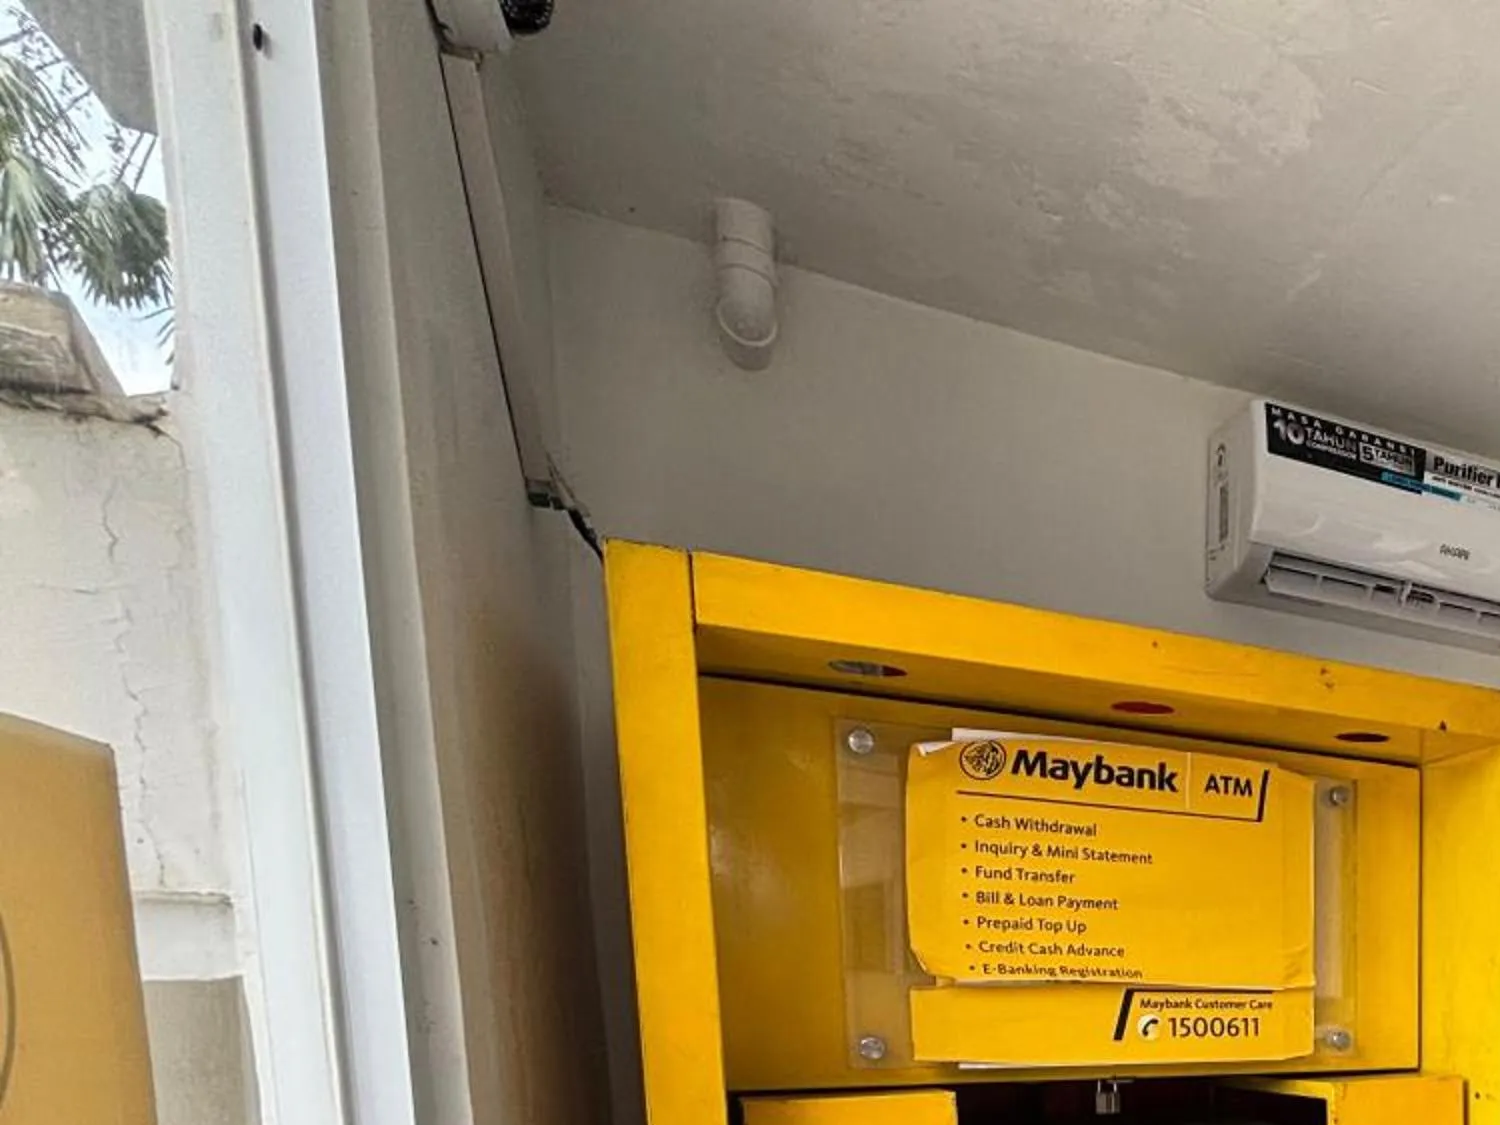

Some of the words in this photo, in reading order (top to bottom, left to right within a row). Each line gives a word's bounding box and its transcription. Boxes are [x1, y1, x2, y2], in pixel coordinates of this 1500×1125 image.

[1271, 406, 1323, 429] MASA
[1273, 418, 1306, 445] 10
[1306, 427, 1357, 451] TAHUN
[1362, 443, 1376, 462] 5
[1433, 455, 1494, 487] Purifier
[1010, 749, 1179, 792] Maybank
[1204, 773, 1253, 798] ATM
[974, 814, 1011, 830] Cash
[1014, 817, 1097, 837] Withdrawal
[974, 839, 1029, 859] Inquiry
[1031, 843, 1042, 857] &
[1046, 845, 1079, 860] Mini
[1082, 848, 1153, 866] Statement
[975, 865, 1013, 881] Fund
[1016, 867, 1076, 884] Transfer
[975, 890, 999, 904] Bill
[1003, 892, 1015, 905] &
[1019, 892, 1051, 907] Loan
[1057, 895, 1119, 912] Payment
[976, 915, 1033, 933] Prepaid
[1037, 917, 1063, 934] Top
[1066, 920, 1087, 935] Up
[978, 940, 1024, 955] Credit
[1028, 943, 1063, 956] Cash
[1066, 944, 1125, 958] Advance
[982, 963, 1057, 977] E-Banking
[1059, 964, 1143, 979] Registration
[1139, 998, 1192, 1011] Maybank
[1195, 998, 1247, 1010] Customer
[1249, 999, 1274, 1010] Care
[1168, 1016, 1259, 1038] 1500611
